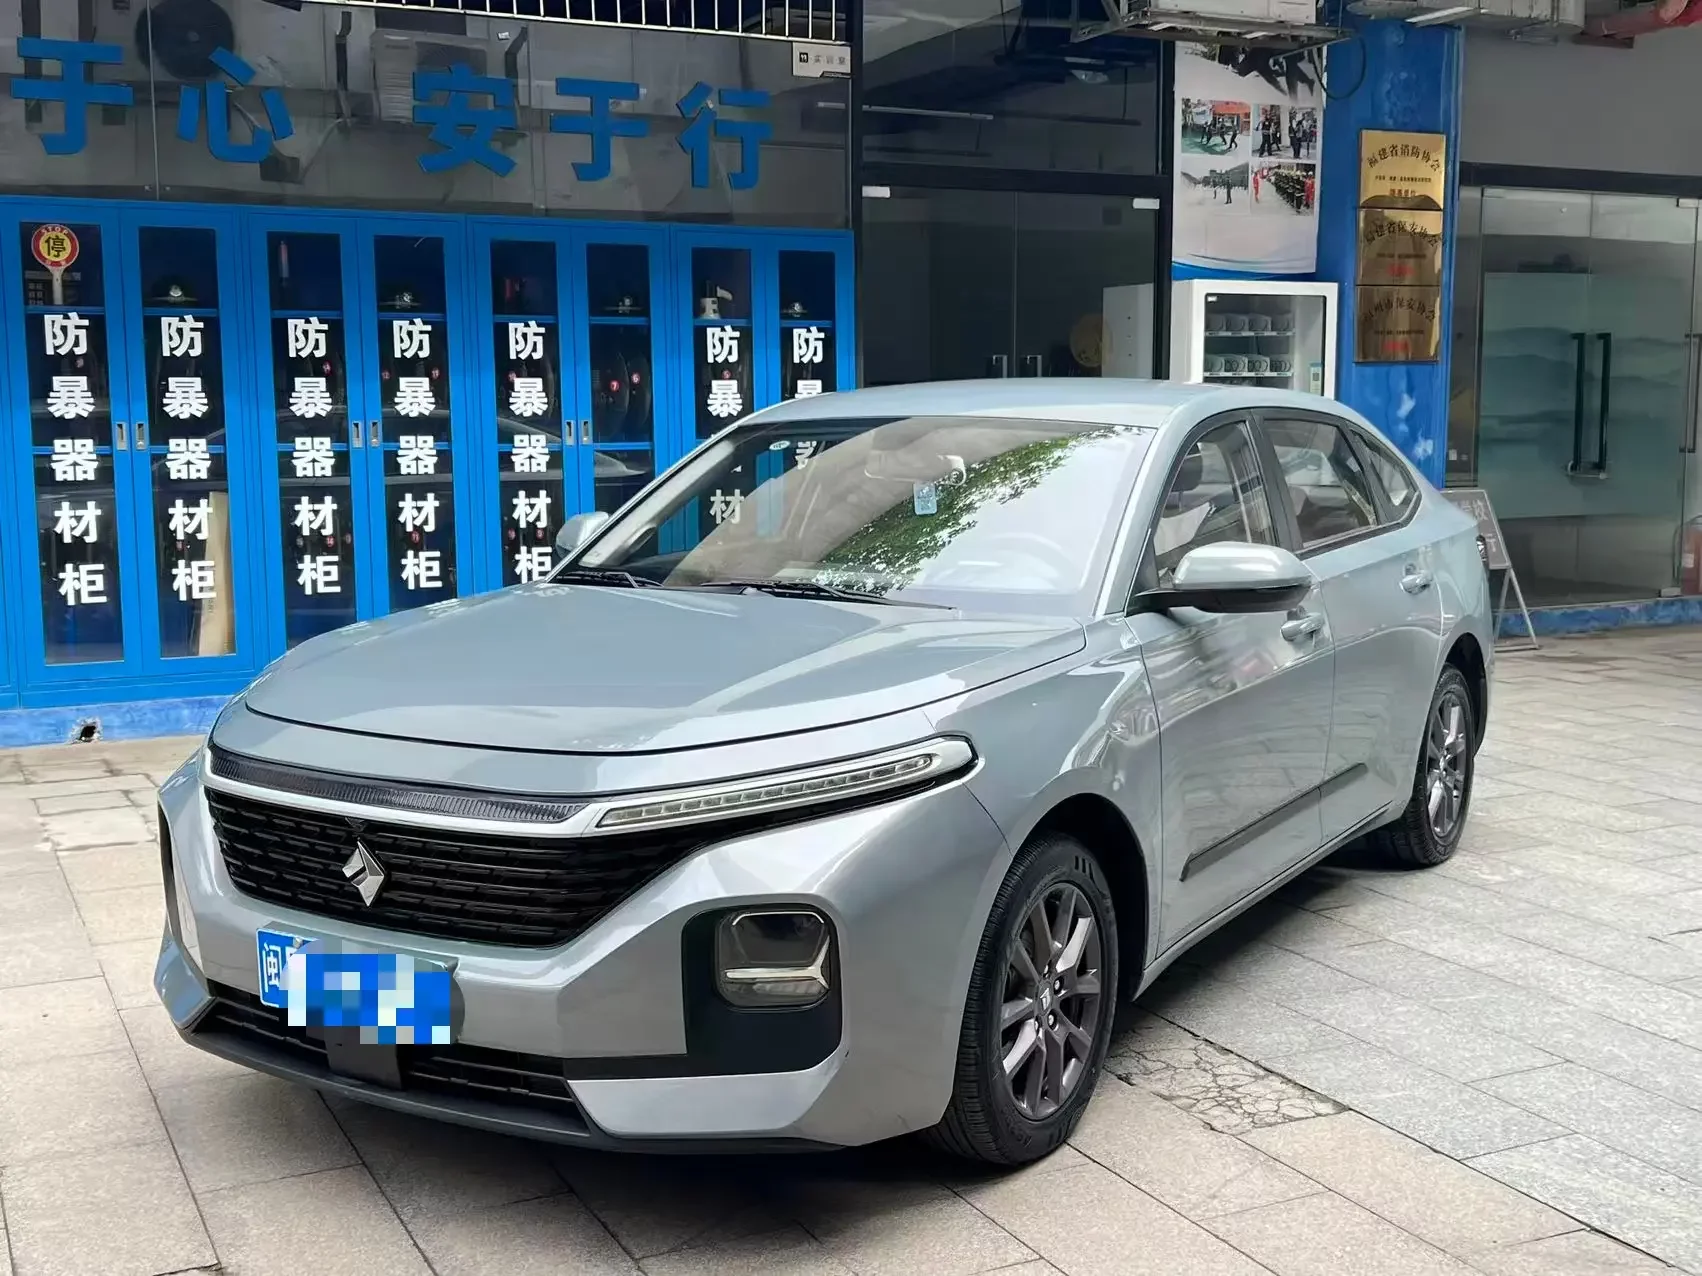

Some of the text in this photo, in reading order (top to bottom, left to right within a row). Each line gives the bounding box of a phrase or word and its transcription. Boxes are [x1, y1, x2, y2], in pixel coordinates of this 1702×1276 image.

[11, 37, 773, 189] 于心 安于行
[41, 226, 69, 236] STOP
[1367, 143, 1441, 171] 福建省消防协会
[45, 235, 66, 258] 停
[44, 312, 107, 606] 防暴器材柜
[161, 315, 217, 601] 防暴器材柜
[287, 317, 341, 595] 防暴器材柜
[393, 319, 443, 590] 防暴器材柜
[508, 321, 552, 584] 防暴器材柜
